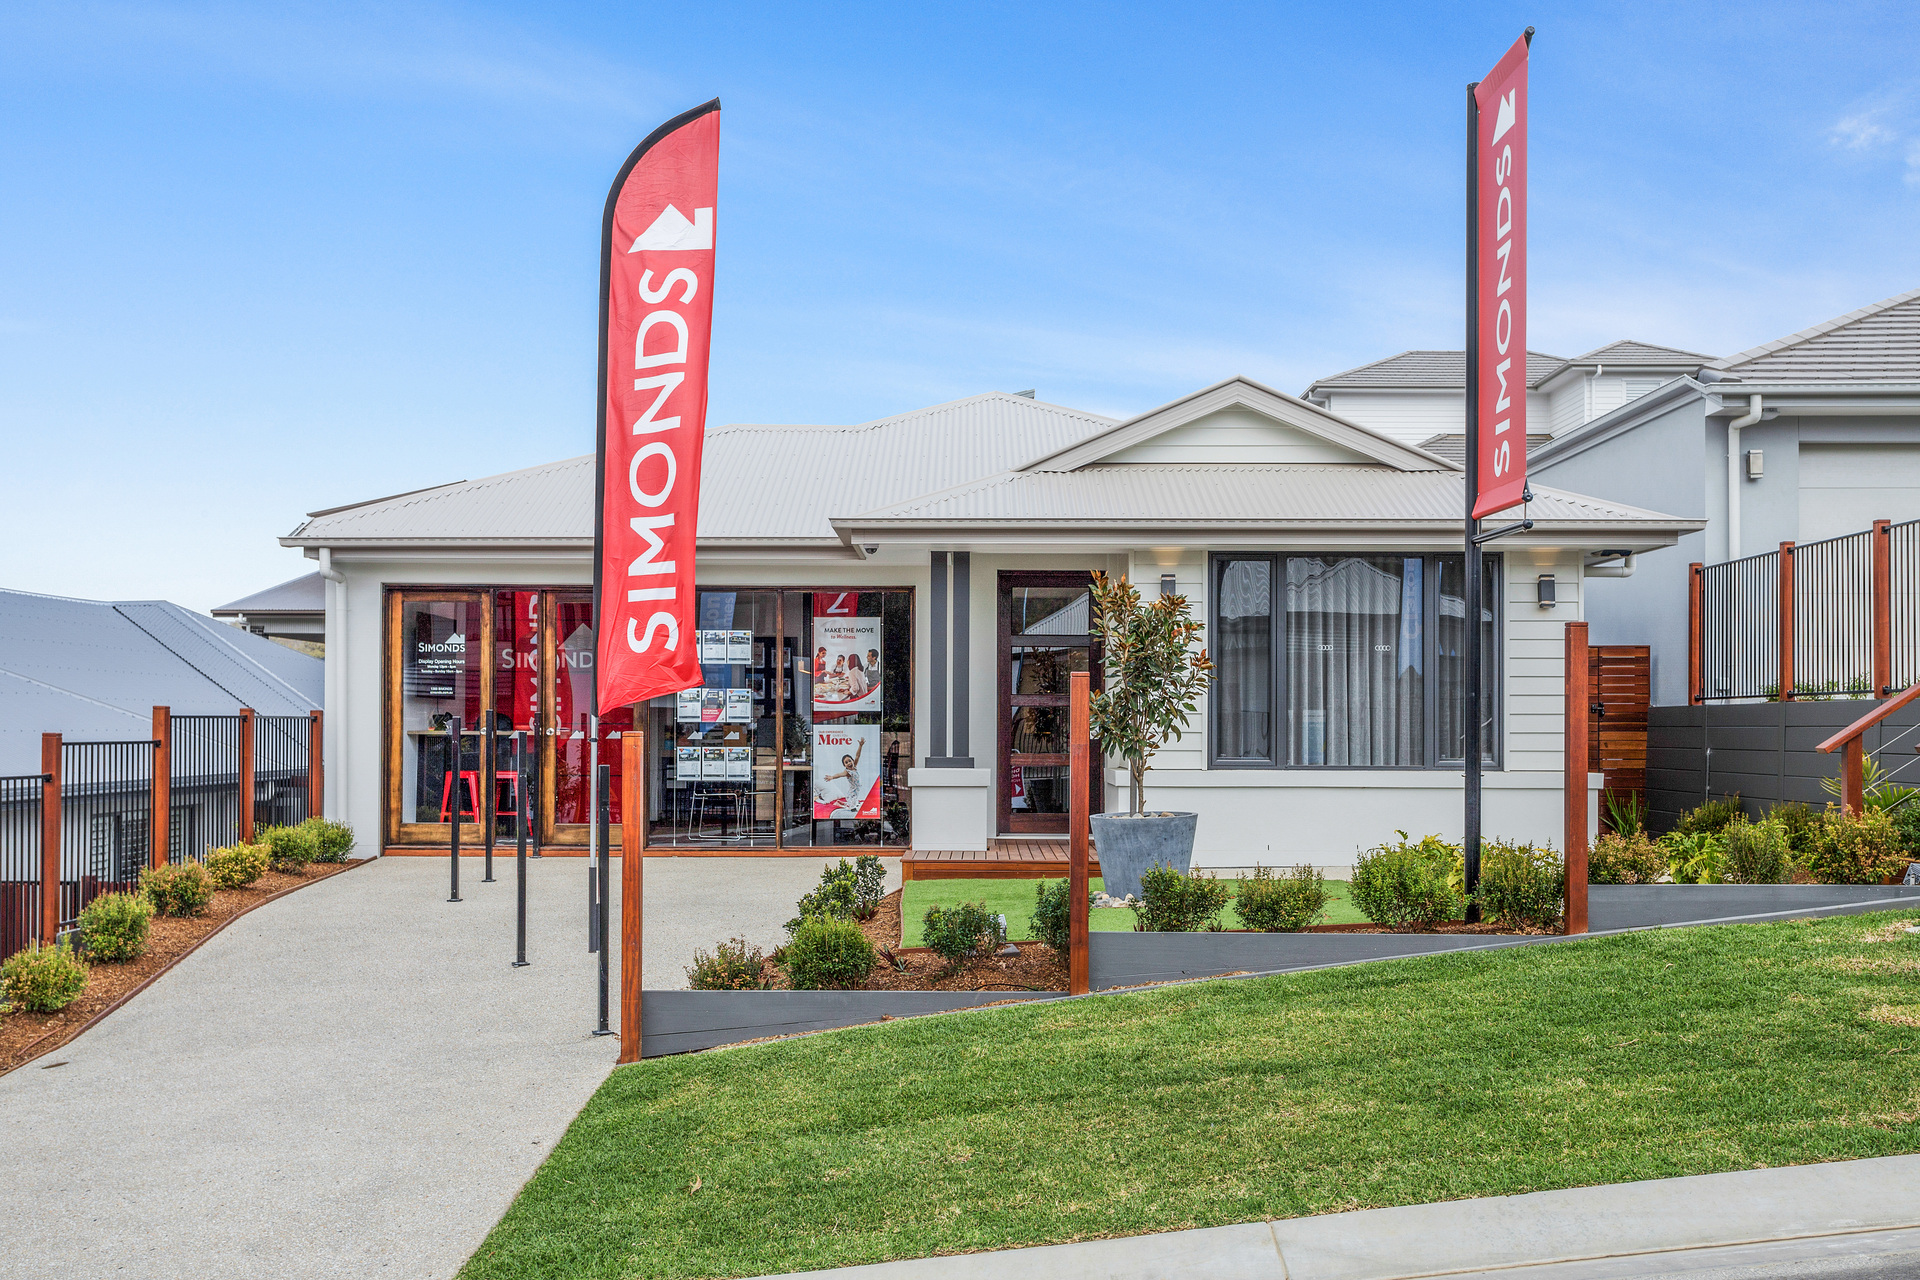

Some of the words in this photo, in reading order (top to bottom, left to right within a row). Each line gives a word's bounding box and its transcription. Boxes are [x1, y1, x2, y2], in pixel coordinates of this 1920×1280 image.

[1494, 144, 1512, 478] SIMONDS
[627, 267, 698, 653] SIMONDS
[418, 642, 466, 652] SIMONDS
[818, 734, 853, 745] More
